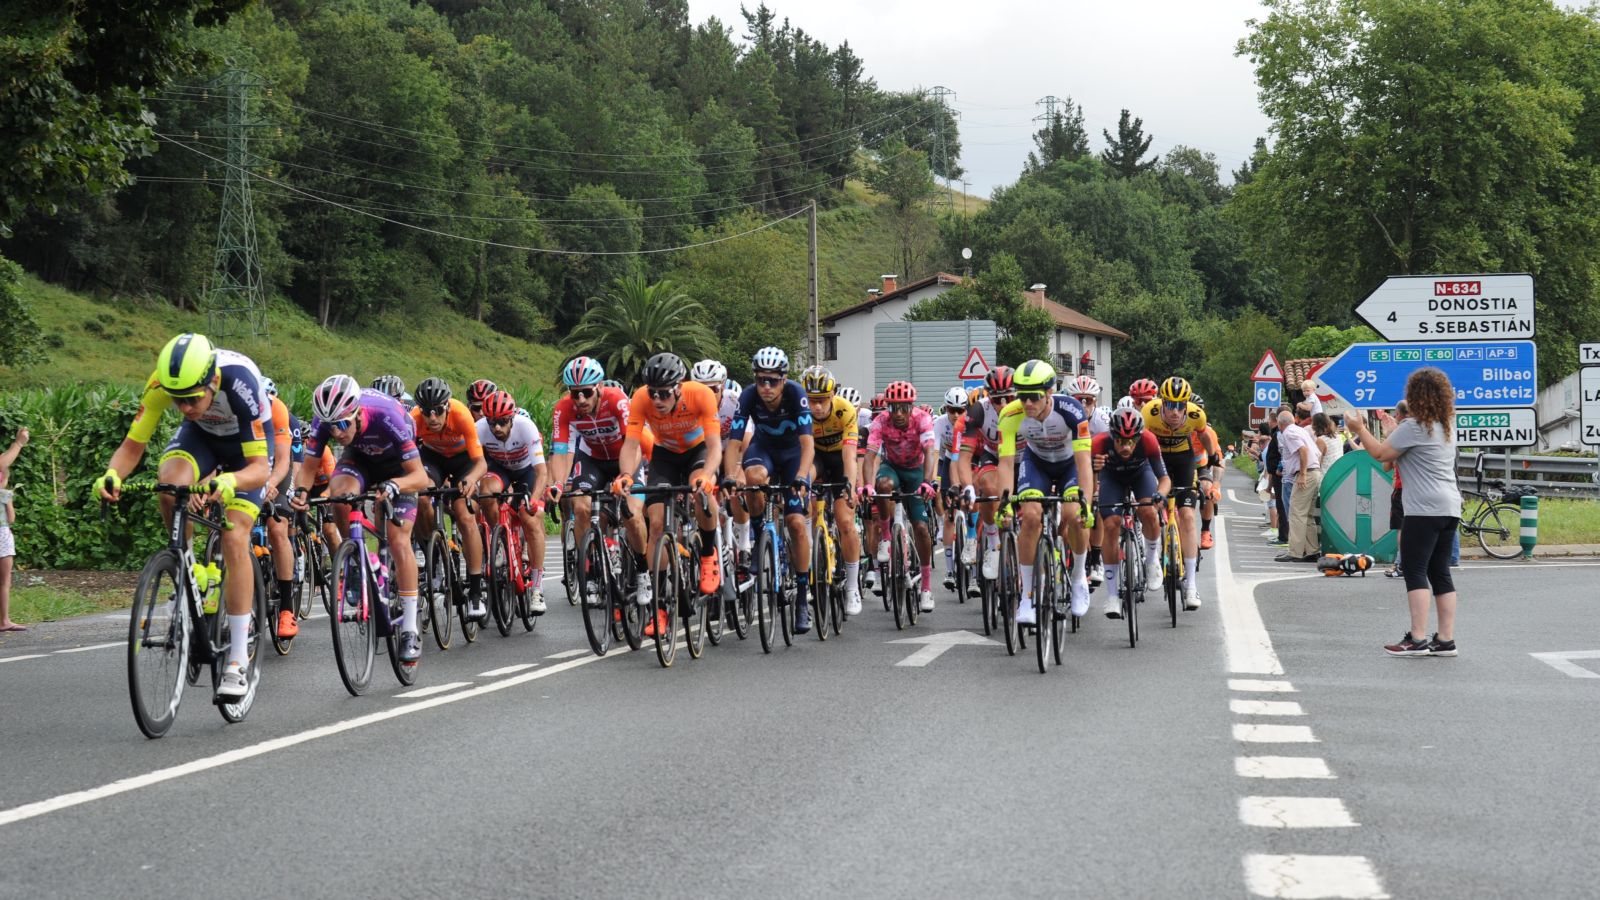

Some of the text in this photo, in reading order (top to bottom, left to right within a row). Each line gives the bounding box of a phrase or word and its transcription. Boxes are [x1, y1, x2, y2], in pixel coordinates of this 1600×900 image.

[1436, 283, 1479, 295] N-634
[1428, 298, 1518, 311] DONOSTIA
[1387, 311, 1397, 323] 4
[1418, 317, 1531, 334] S.SEBASTIÁN
[1371, 348, 1515, 361] E-5 E-70 E-80 AP-1 AP-8
[1582, 347, 1600, 359] Tx
[1355, 368, 1532, 383] 95 Bilbao
[232, 378, 259, 416] Wallonie
[1256, 388, 1279, 401] 60
[1354, 386, 1532, 401] 97 ia-Gasteiz
[1584, 389, 1600, 402] LA
[1059, 400, 1083, 420] Wallonie
[1458, 415, 1509, 427] GI-2132
[1457, 429, 1532, 442] HERNANI
[1585, 425, 1600, 437] Zu
